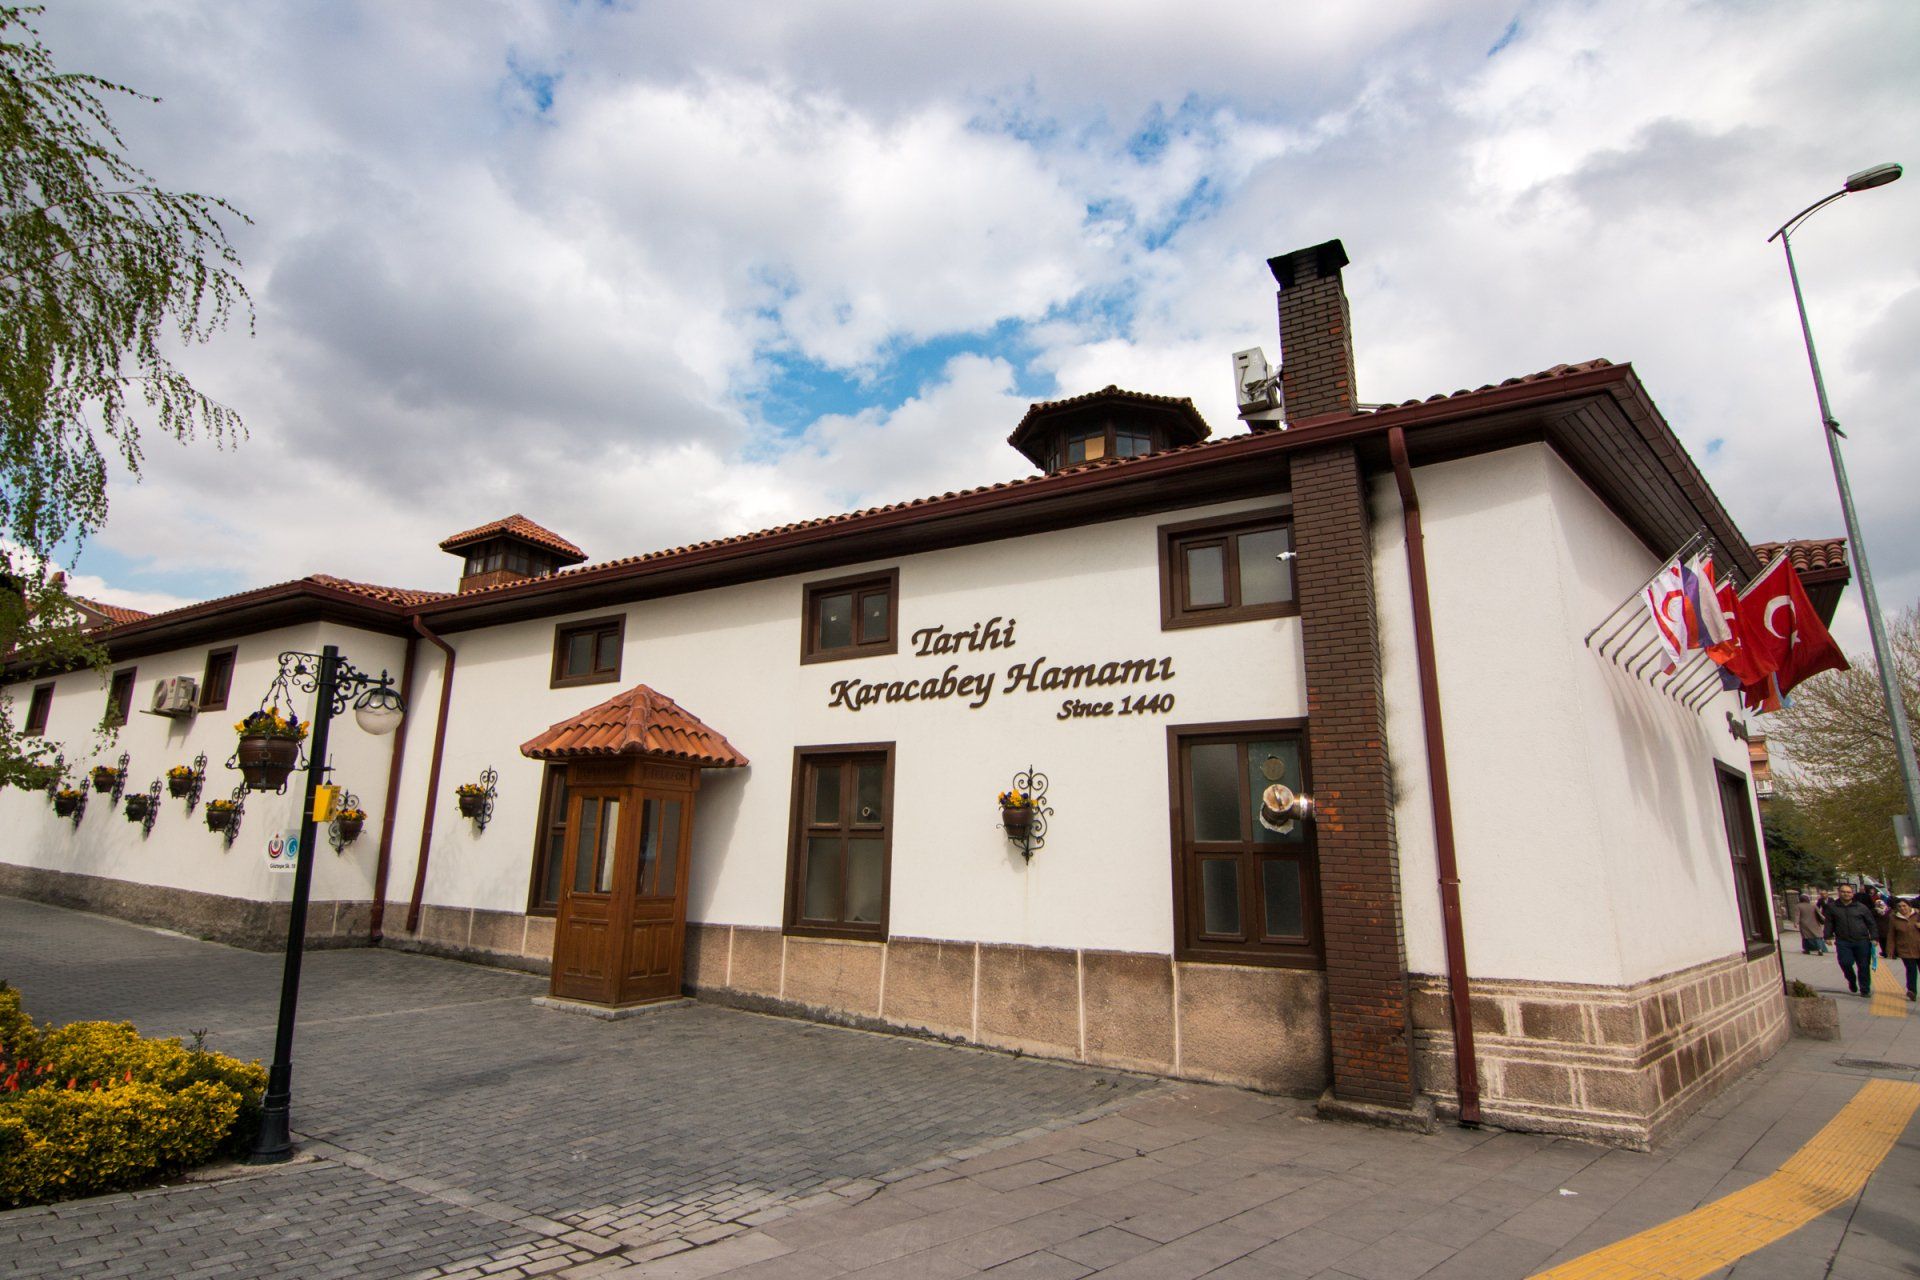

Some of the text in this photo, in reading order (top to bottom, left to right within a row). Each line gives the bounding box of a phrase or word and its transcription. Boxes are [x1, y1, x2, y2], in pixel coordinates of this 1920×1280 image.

[911, 616, 1016, 657] Tarihi
[828, 656, 1176, 712] Karacabey Hamamı
[1056, 694, 1175, 720] Since 1440
